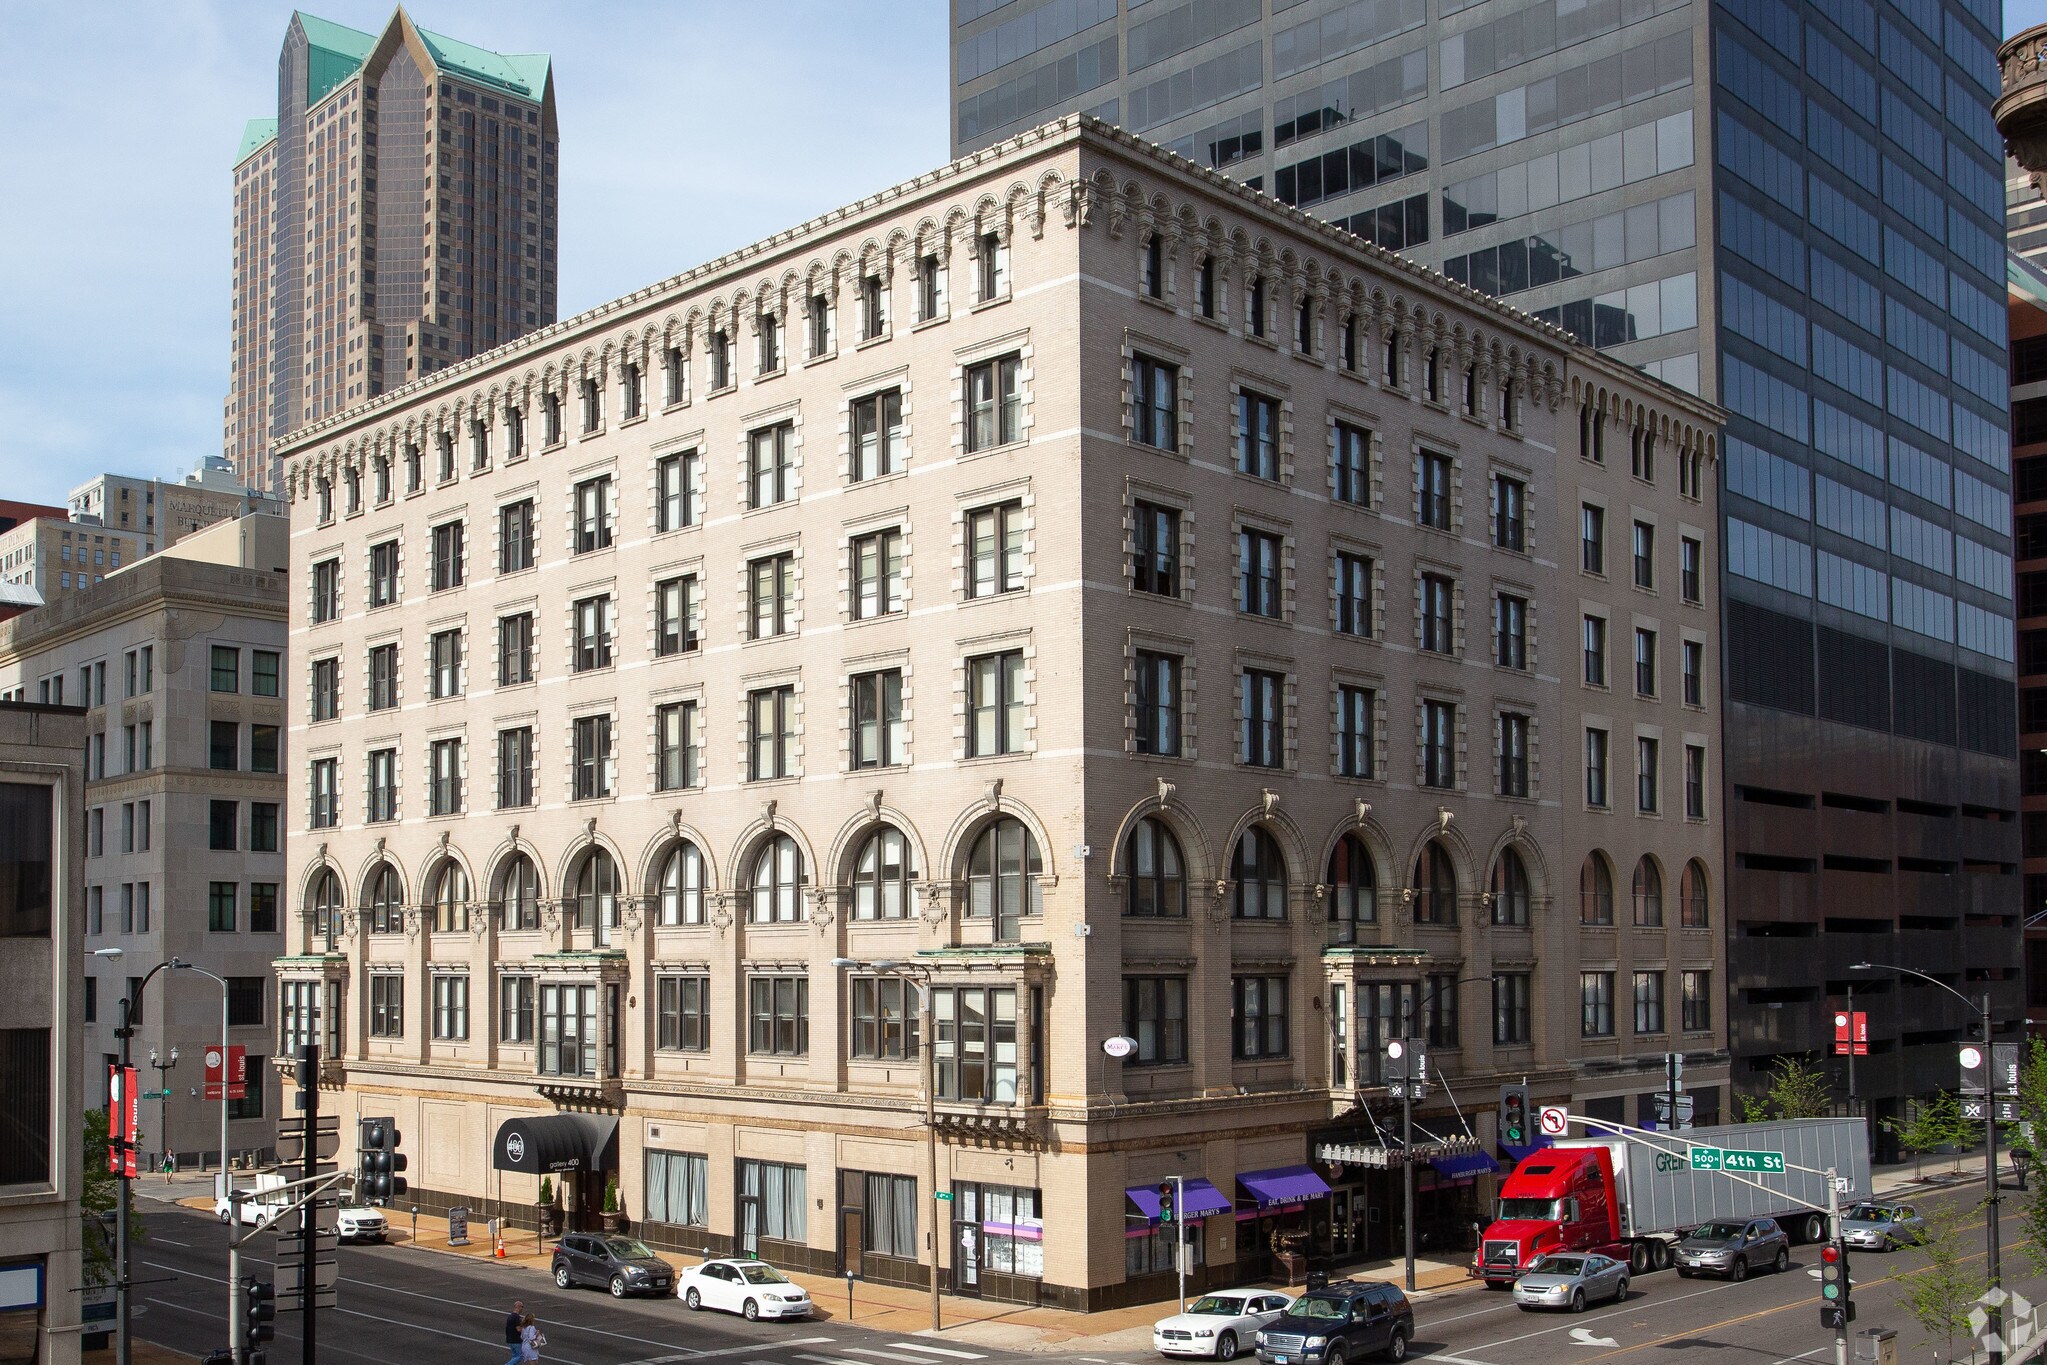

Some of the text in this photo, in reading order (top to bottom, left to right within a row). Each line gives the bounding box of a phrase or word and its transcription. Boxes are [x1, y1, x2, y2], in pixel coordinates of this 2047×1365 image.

[2006, 1064, 2017, 1084] louis
[2007, 1085, 2017, 1095] st.
[549, 1158, 580, 1169] gallery 400
[1655, 1151, 1687, 1172] GREIF
[1694, 1154, 1714, 1163] 500
[1725, 1154, 1782, 1169] 4th St
[1280, 1196, 1296, 1204] DRINK
[1310, 1191, 1325, 1200] MARY
[1199, 1208, 1220, 1217] MARY'S
